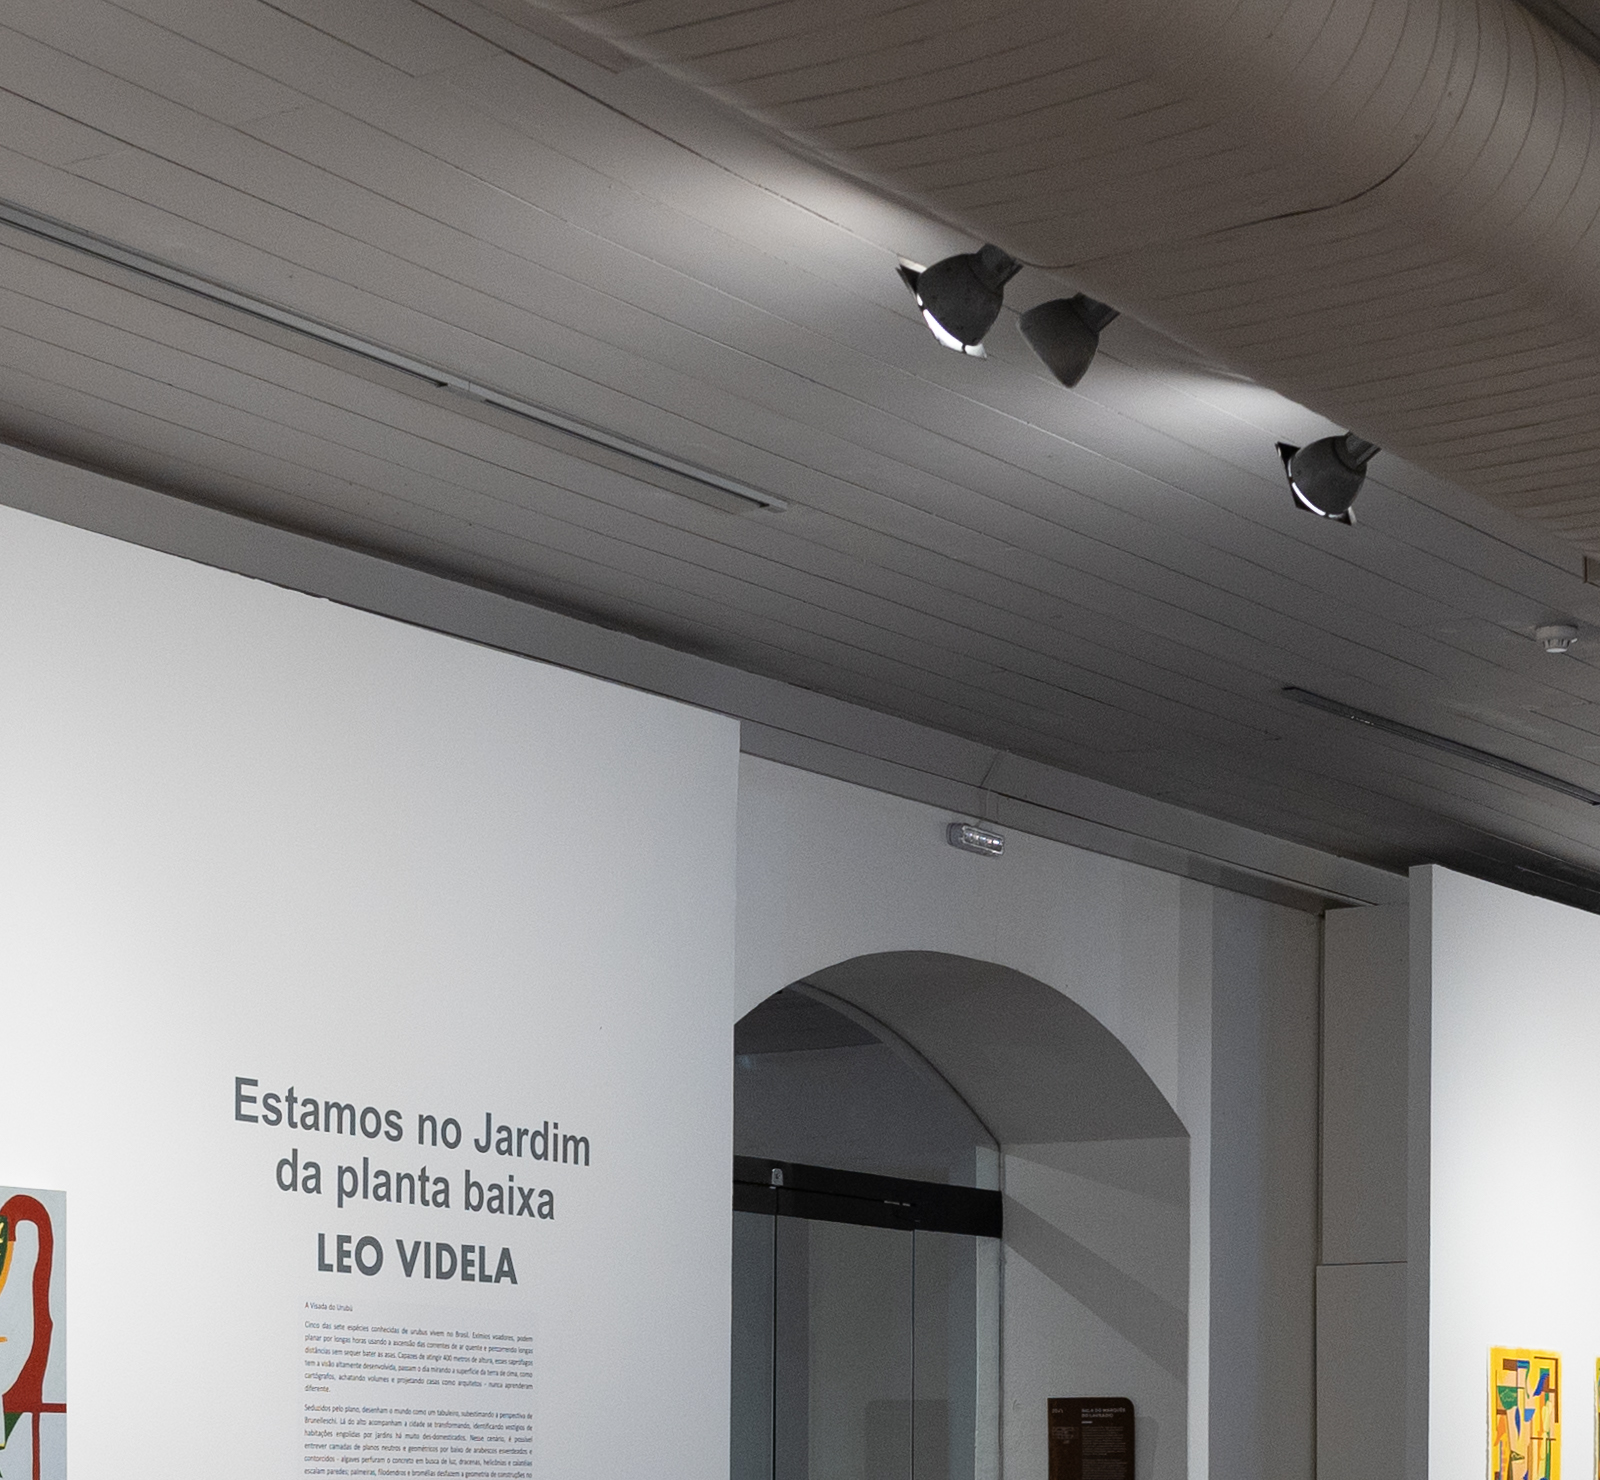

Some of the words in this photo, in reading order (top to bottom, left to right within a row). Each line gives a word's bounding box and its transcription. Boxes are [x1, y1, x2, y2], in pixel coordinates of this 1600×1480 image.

[234, 1076, 404, 1143] Estamos
[418, 1110, 462, 1150] no
[474, 1112, 591, 1167] Jardim
[276, 1148, 322, 1195] da
[337, 1157, 450, 1209] planta
[464, 1169, 555, 1220] baixa
[318, 1232, 384, 1277] LEO
[396, 1238, 518, 1285] VIDELA
[310, 1302, 328, 1310] Visada
